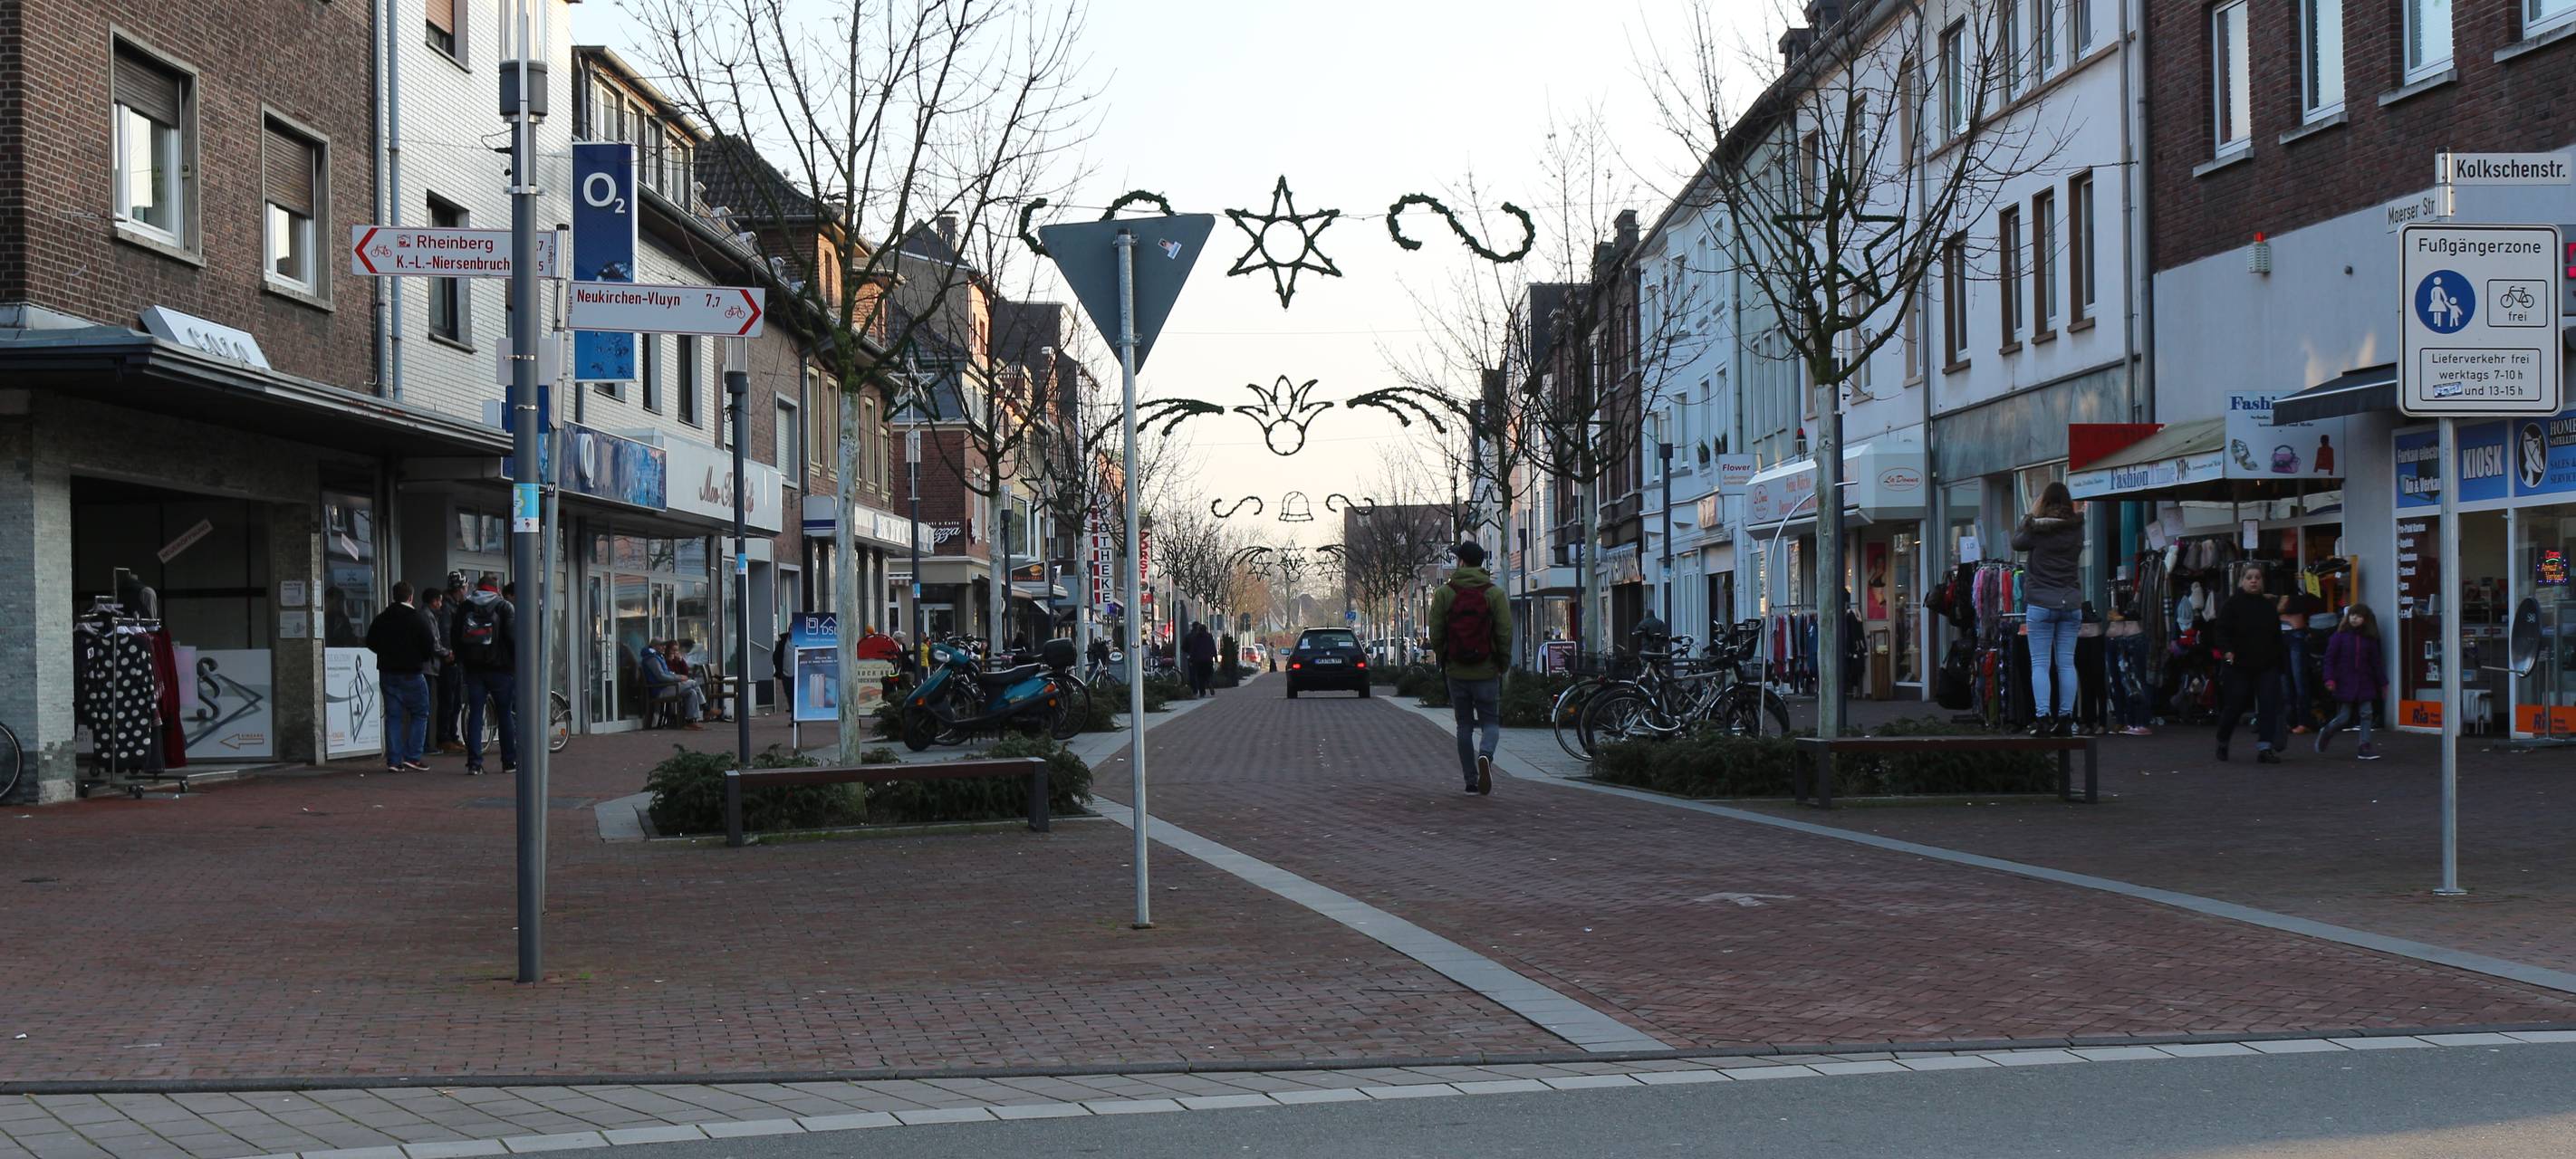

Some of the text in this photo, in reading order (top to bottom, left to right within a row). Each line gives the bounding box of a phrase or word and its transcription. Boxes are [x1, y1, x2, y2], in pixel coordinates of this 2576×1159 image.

[2456, 158, 2567, 179] Kolkschenstr.
[2388, 204, 2419, 225] Moerser
[416, 235, 495, 253] Rheinberg
[2417, 236, 2542, 257] Fußgängerzone
[396, 254, 511, 272] K.-L.-Niersenbruch
[576, 288, 681, 309] Neukirchen-Vluyn
[2508, 311, 2528, 322] frei
[2431, 352, 2530, 365] Lieferverkehr frei
[2439, 369, 2523, 384] werktags 7-10 h
[2465, 385, 2523, 397] und 13-15 h
[2463, 445, 2503, 479] KIOSK
[2110, 465, 2148, 490] Fashion
